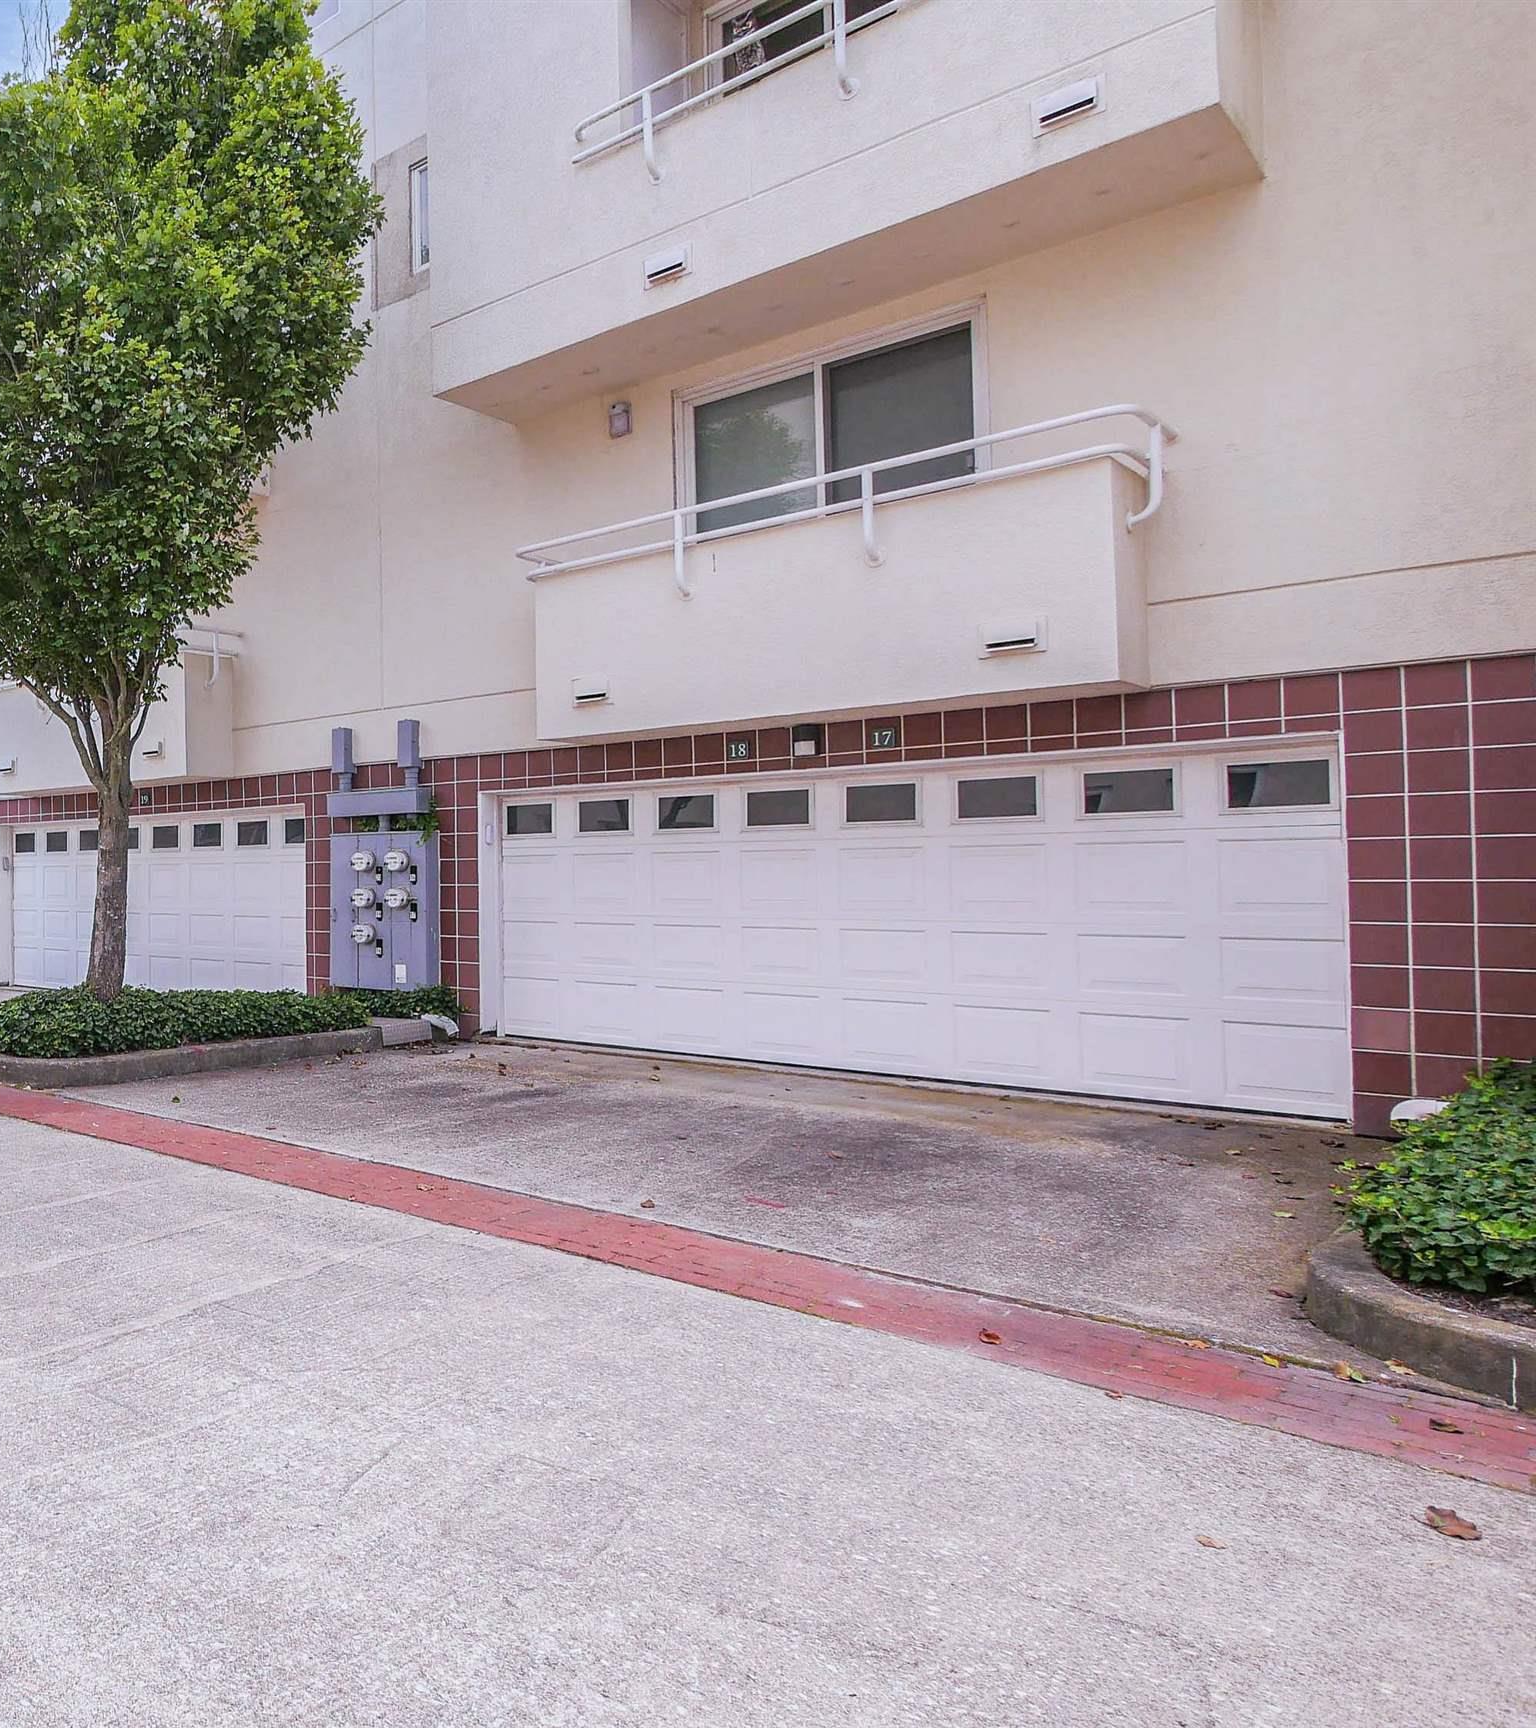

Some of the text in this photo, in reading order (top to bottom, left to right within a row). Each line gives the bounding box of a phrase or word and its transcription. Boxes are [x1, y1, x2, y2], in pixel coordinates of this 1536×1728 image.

[873, 731, 892, 746] 17
[729, 743, 746, 757] 18
[140, 795, 149, 805] 19
